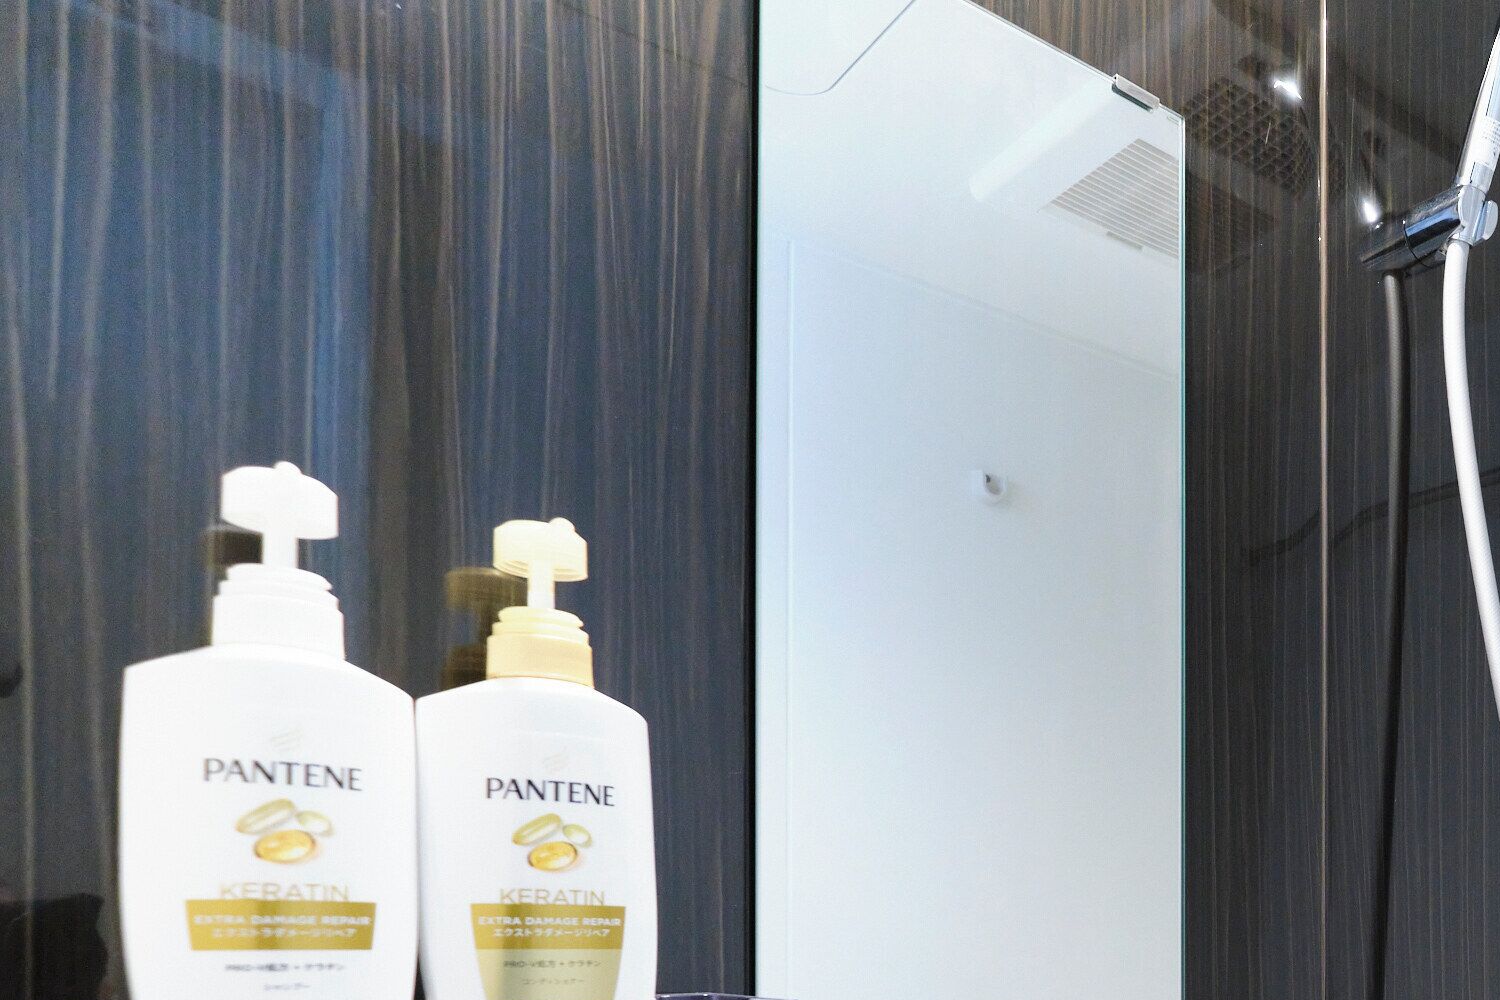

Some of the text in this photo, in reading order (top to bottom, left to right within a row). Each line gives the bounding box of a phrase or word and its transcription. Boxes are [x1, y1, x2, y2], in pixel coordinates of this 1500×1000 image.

[203, 757, 363, 792] PANTENE
[486, 777, 615, 807] PANTENE
[220, 882, 349, 900] KERATIN
[500, 887, 605, 905] KERATIN
[194, 914, 371, 926] EXTRA DAMAGE REPAIR
[478, 916, 622, 927] EXTRA DAMAGE REPAIR
